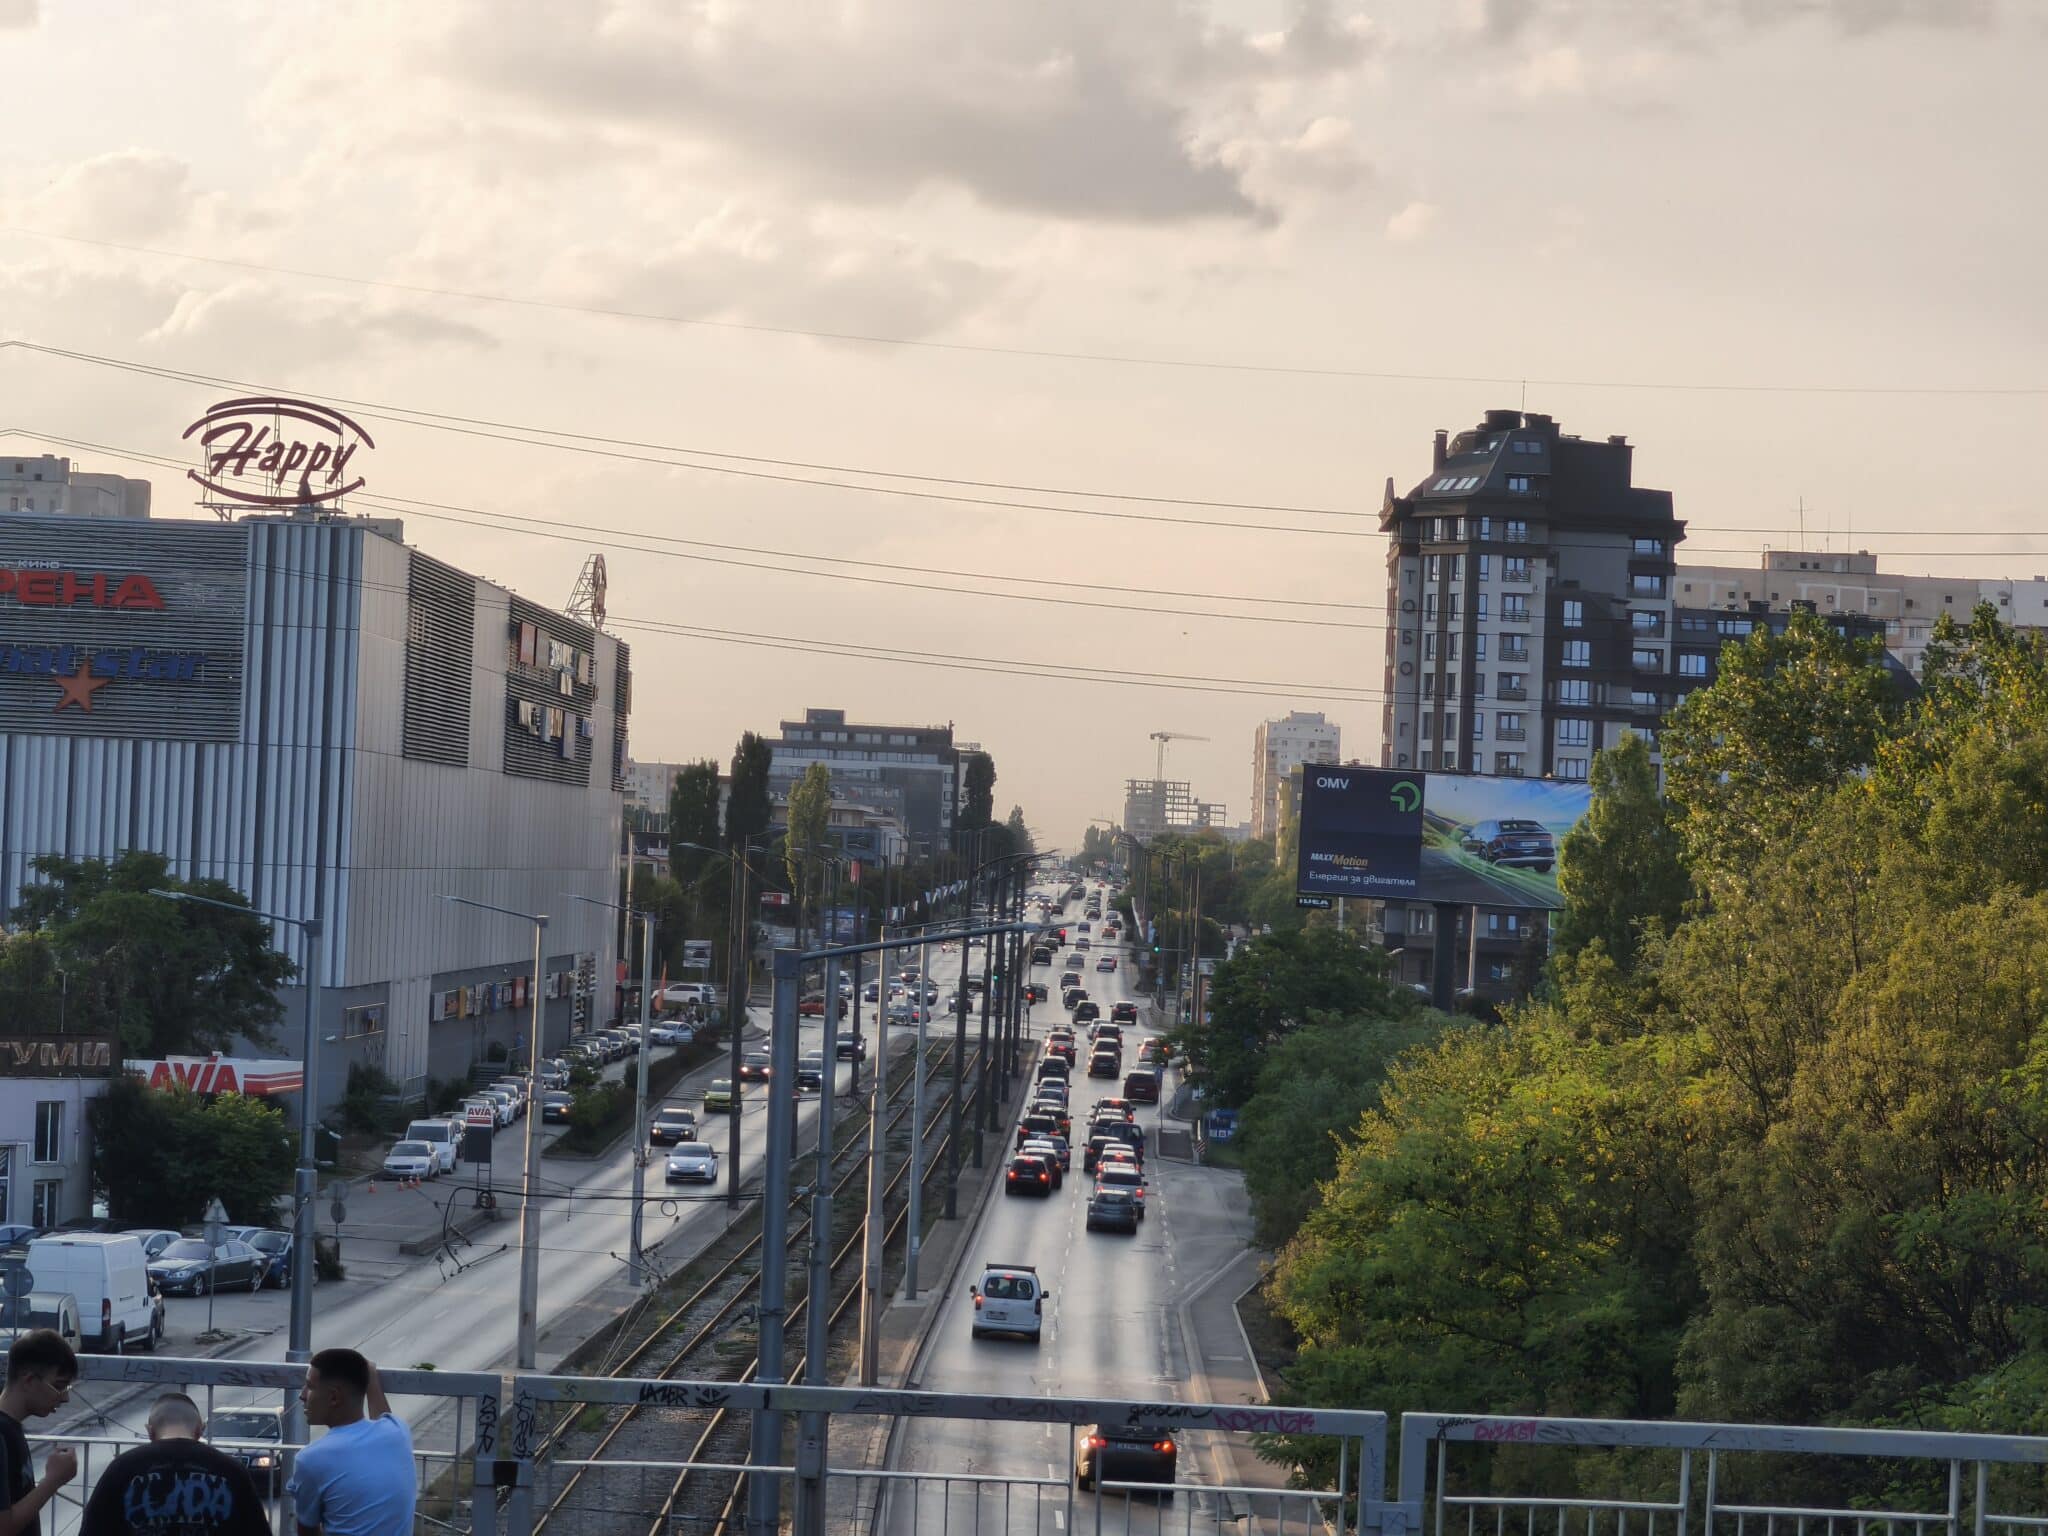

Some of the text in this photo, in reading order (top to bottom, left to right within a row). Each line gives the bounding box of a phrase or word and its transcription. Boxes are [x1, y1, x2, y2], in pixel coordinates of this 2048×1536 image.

[201, 422, 357, 485] Happy
[1316, 777, 1350, 789] OMV
[467, 1107, 492, 1116] AVIA
